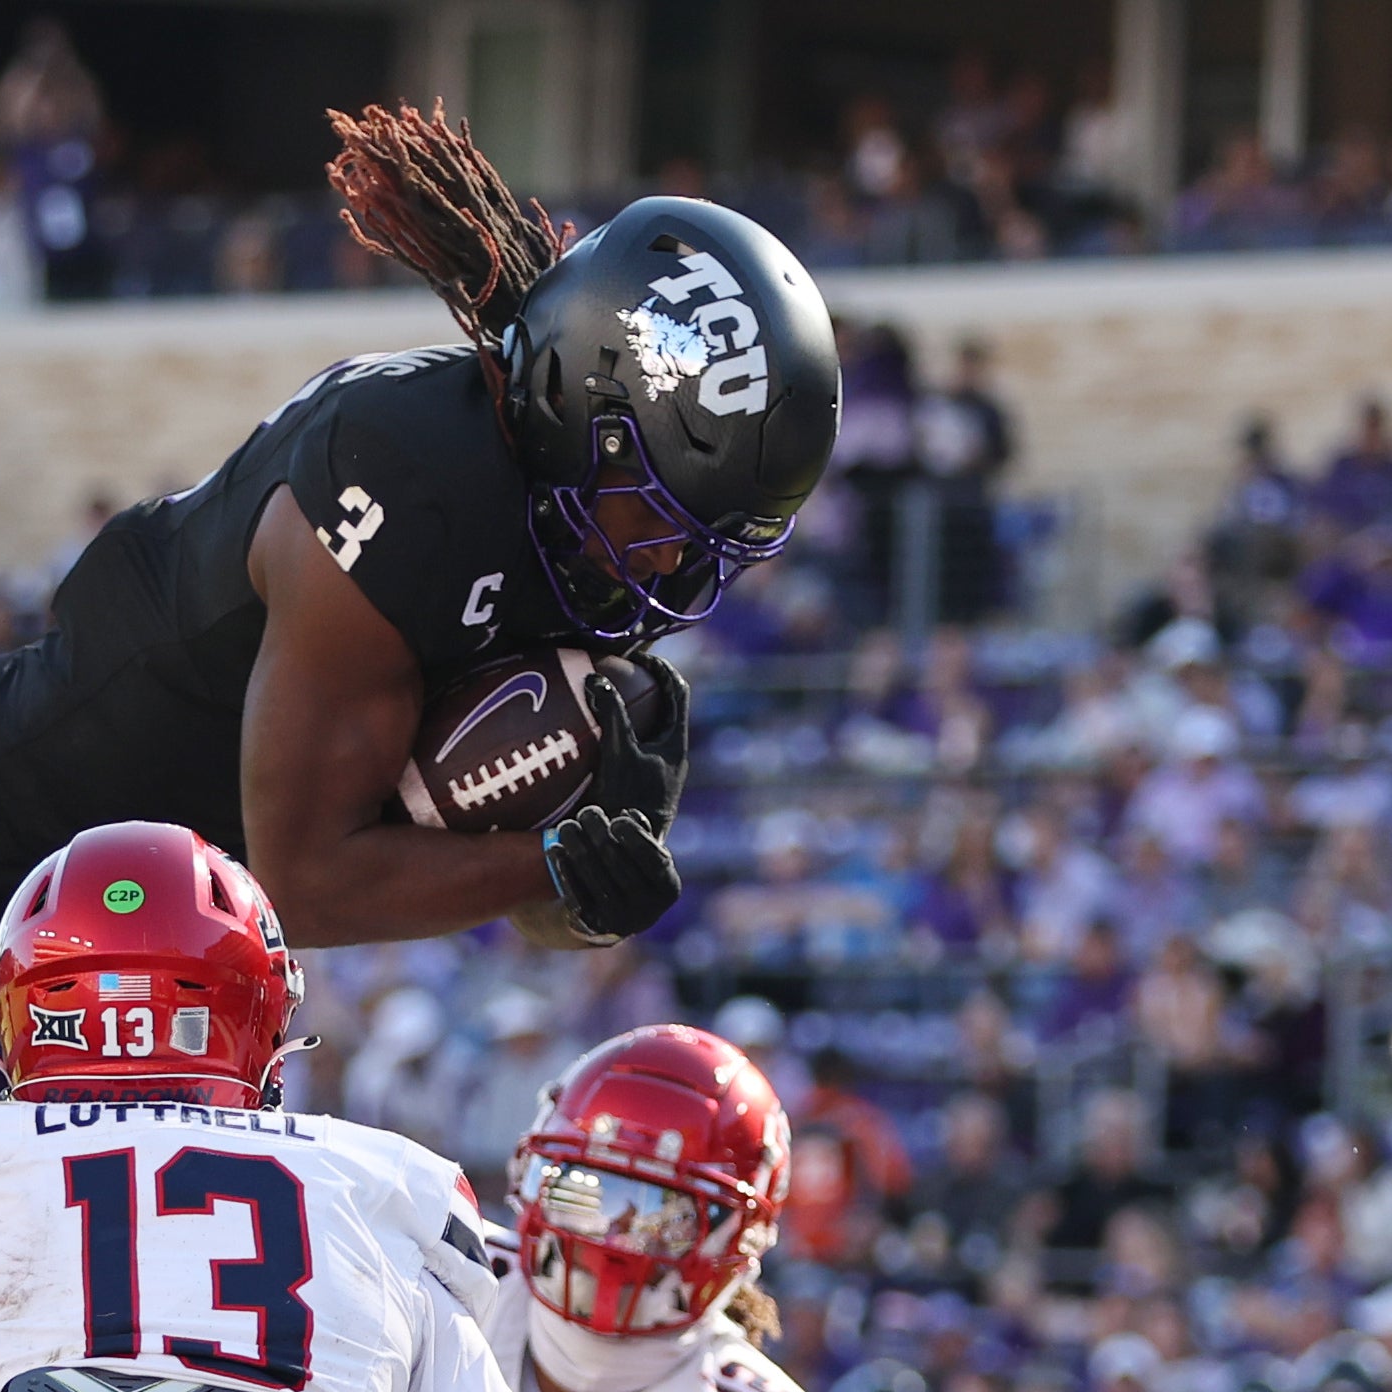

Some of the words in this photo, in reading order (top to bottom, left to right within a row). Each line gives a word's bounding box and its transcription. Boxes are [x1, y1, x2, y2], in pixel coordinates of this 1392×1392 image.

[648, 252, 769, 417] TCU
[316, 485, 385, 572] 3
[461, 572, 505, 628] C
[106, 889, 141, 903] C2P
[100, 1006, 154, 1057] 13
[62, 1145, 314, 1392] 13
